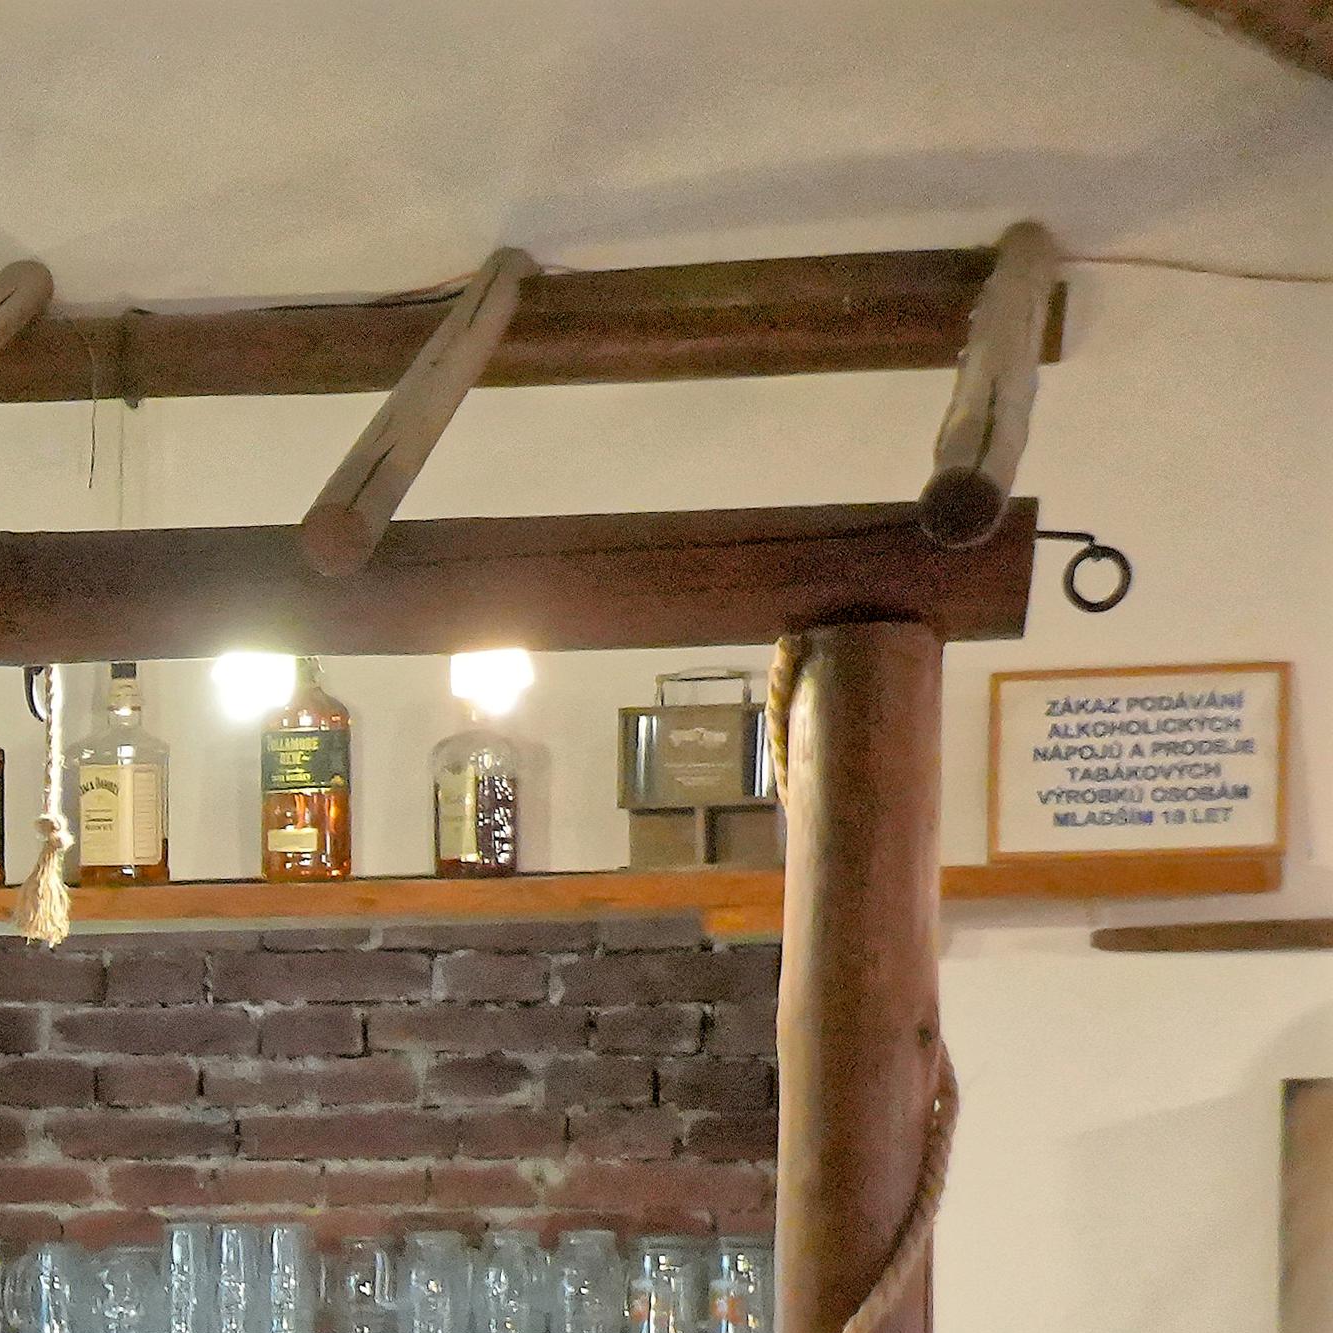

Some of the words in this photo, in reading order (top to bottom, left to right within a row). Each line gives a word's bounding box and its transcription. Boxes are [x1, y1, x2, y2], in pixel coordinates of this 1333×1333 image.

[1045, 697, 1120, 716] ZÁKAZ
[1047, 715, 1242, 739] ALKOHOLICKÝCH
[1129, 743, 1145, 758] A
[1066, 762, 1222, 782] TABÁKOVÝCH
[1191, 807, 1234, 823] LET
